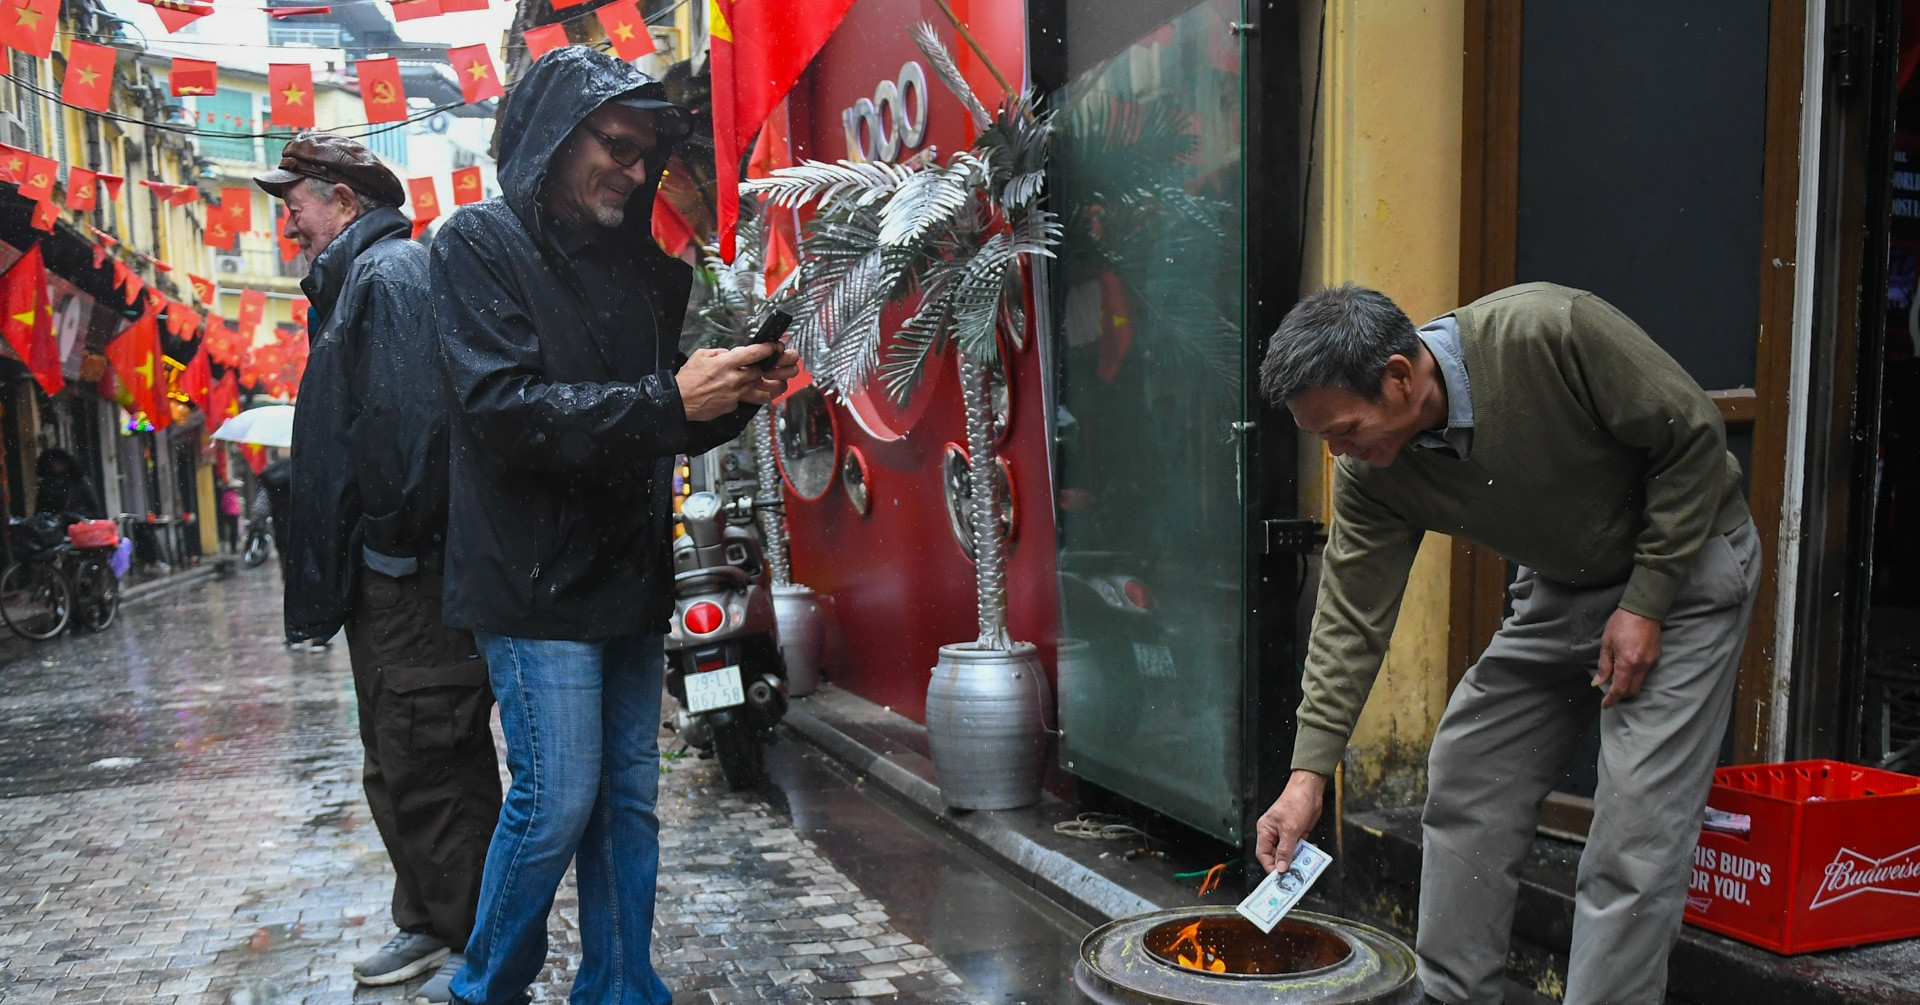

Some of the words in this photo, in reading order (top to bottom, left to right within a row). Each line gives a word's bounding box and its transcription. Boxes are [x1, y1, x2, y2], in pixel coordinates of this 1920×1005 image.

[1693, 845, 1717, 870] HIS
[1720, 852, 1771, 886] BUD'S
[1824, 857, 1920, 891] Budweise
[1689, 869, 1709, 893] OR
[1714, 874, 1751, 906] YOU.
